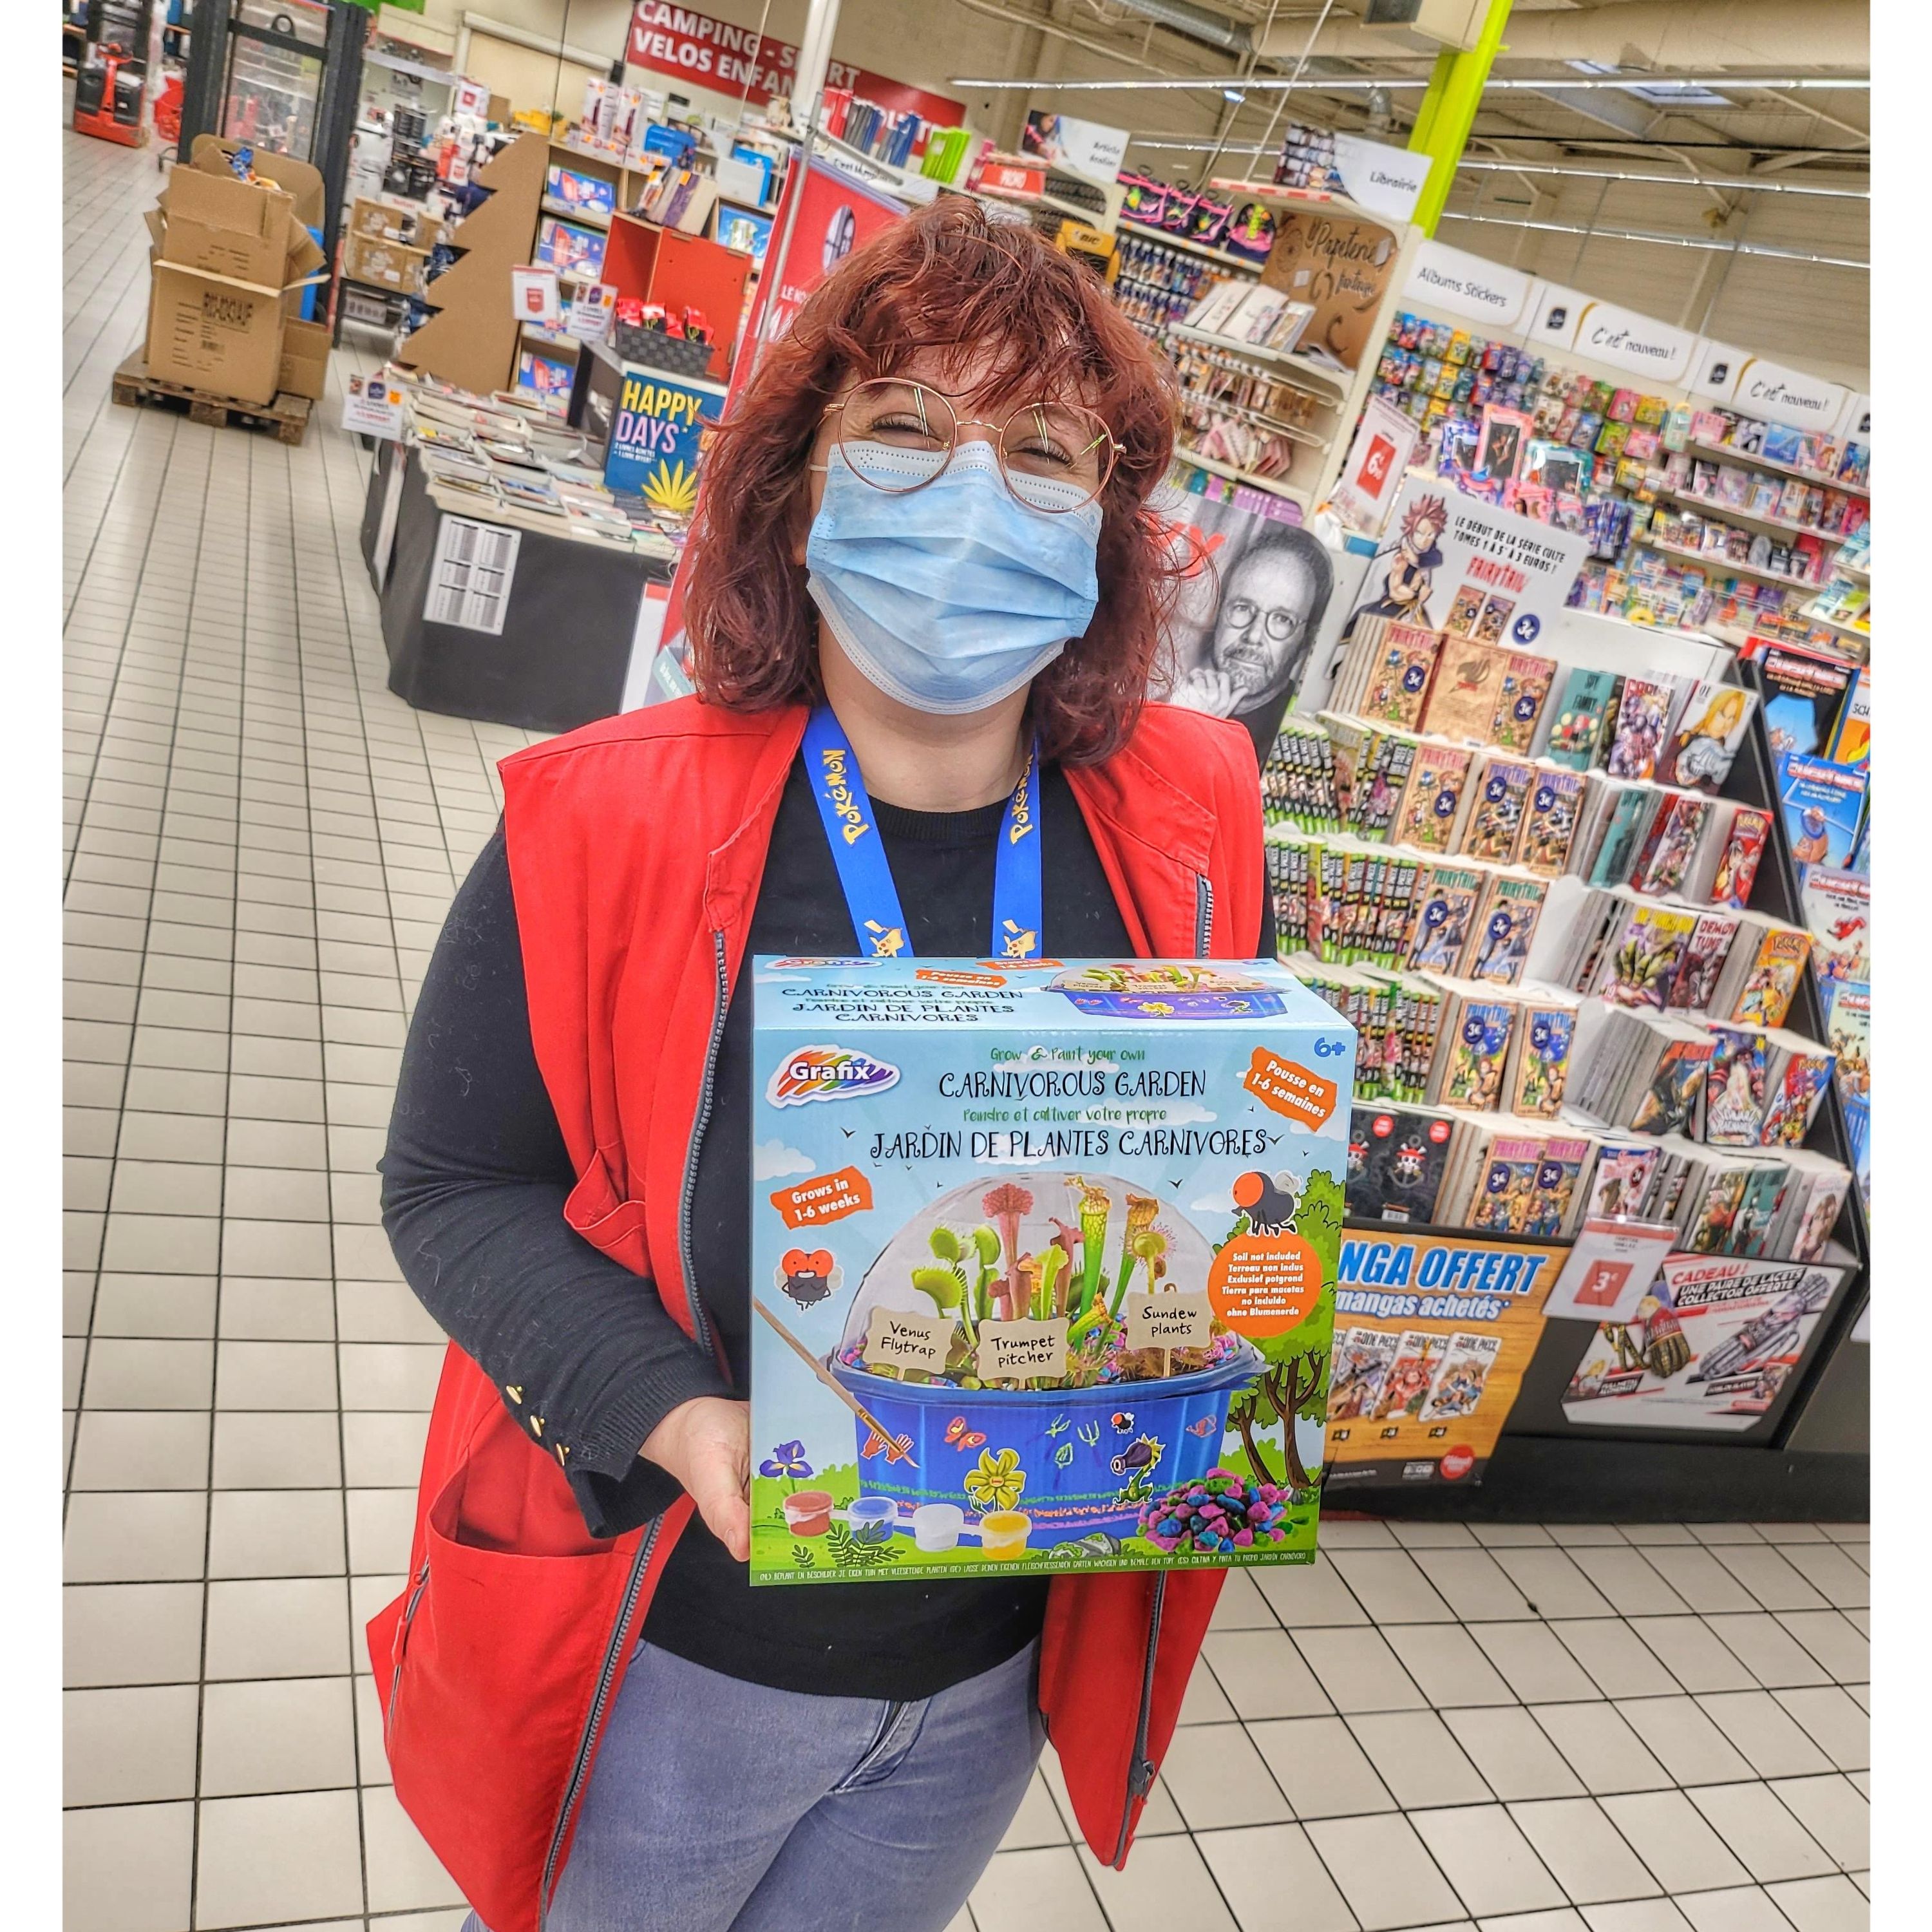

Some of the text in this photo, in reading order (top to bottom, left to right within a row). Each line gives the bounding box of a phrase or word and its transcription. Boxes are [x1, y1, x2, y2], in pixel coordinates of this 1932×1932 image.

[638, 0, 761, 57] CAMPING
[634, 28, 714, 73] VELOS
[1370, 171, 1417, 193] Librairie
[1417, 267, 1508, 307] Albums Stickers
[1625, 341, 1669, 359] nouveau
[621, 379, 703, 426] HAPPY
[1781, 393, 1822, 411] nouveau
[1454, 516, 1466, 527] LE
[1466, 520, 1493, 538] DÉBUT
[1494, 530, 1506, 542] DE
[1506, 534, 1517, 545] LA
[1542, 547, 1566, 564] CULTE
[1453, 529, 1481, 548] TOMES
[1515, 552, 1522, 562] 3
[1522, 554, 1551, 573] EUROS
[782, 989, 1023, 999] CARNIVOROUS GARDEN
[793, 1003, 877, 1012] JARDIN
[921, 1005, 1015, 1013] PLANTES
[835, 1013, 979, 1022] CARNIVORES
[990, 1045, 1145, 1065] Grow & Paint your own
[1314, 1037, 1346, 1058] 6+
[788, 1060, 873, 1081] Grafix
[1265, 1059, 1325, 1097] Pousse en
[939, 1069, 1206, 1098] CARNIVOROUS GARDEN
[1251, 1072, 1327, 1119] 1-6 semaines
[963, 1107, 1009, 1122] Peindre
[1014, 1108, 1029, 1122] et
[1086, 1103, 1122, 1121] votre
[1126, 1108, 1167, 1125] propre
[870, 1128, 1267, 1159] JARDIN DE PLANTES CARNIVORES
[791, 1178, 849, 1206] Grows in
[793, 1191, 861, 1222] 1-6 weeks
[1233, 1251, 1301, 1262] Soil not included
[1228, 1264, 1260, 1273] Terreau
[1280, 1262, 1304, 1271] inclus
[1338, 1240, 1549, 1295] NGA OFFERT
[1227, 1273, 1303, 1285] Exclusief potgrond
[1680, 1268, 1804, 1296] UNE PAIRE DE LACETS
[1222, 1285, 1305, 1296] Tierra para macetas
[1254, 1295, 1287, 1305] incluido
[1677, 1280, 1796, 1305] COLLECTOR OFFERTE
[1142, 1306, 1197, 1321] Sundew
[1226, 1306, 1300, 1316] ohne Blumenerde
[1336, 1290, 1501, 1320] mangas achetés
[889, 1320, 933, 1341] Venus
[1151, 1322, 1192, 1338] plants
[880, 1336, 937, 1359] Flytrap
[990, 1334, 1056, 1354] Trumpet
[998, 1350, 1054, 1368] pitcher
[1073, 1560, 1092, 1568] GARTEN
[1163, 1557, 1175, 1565] TOPF
